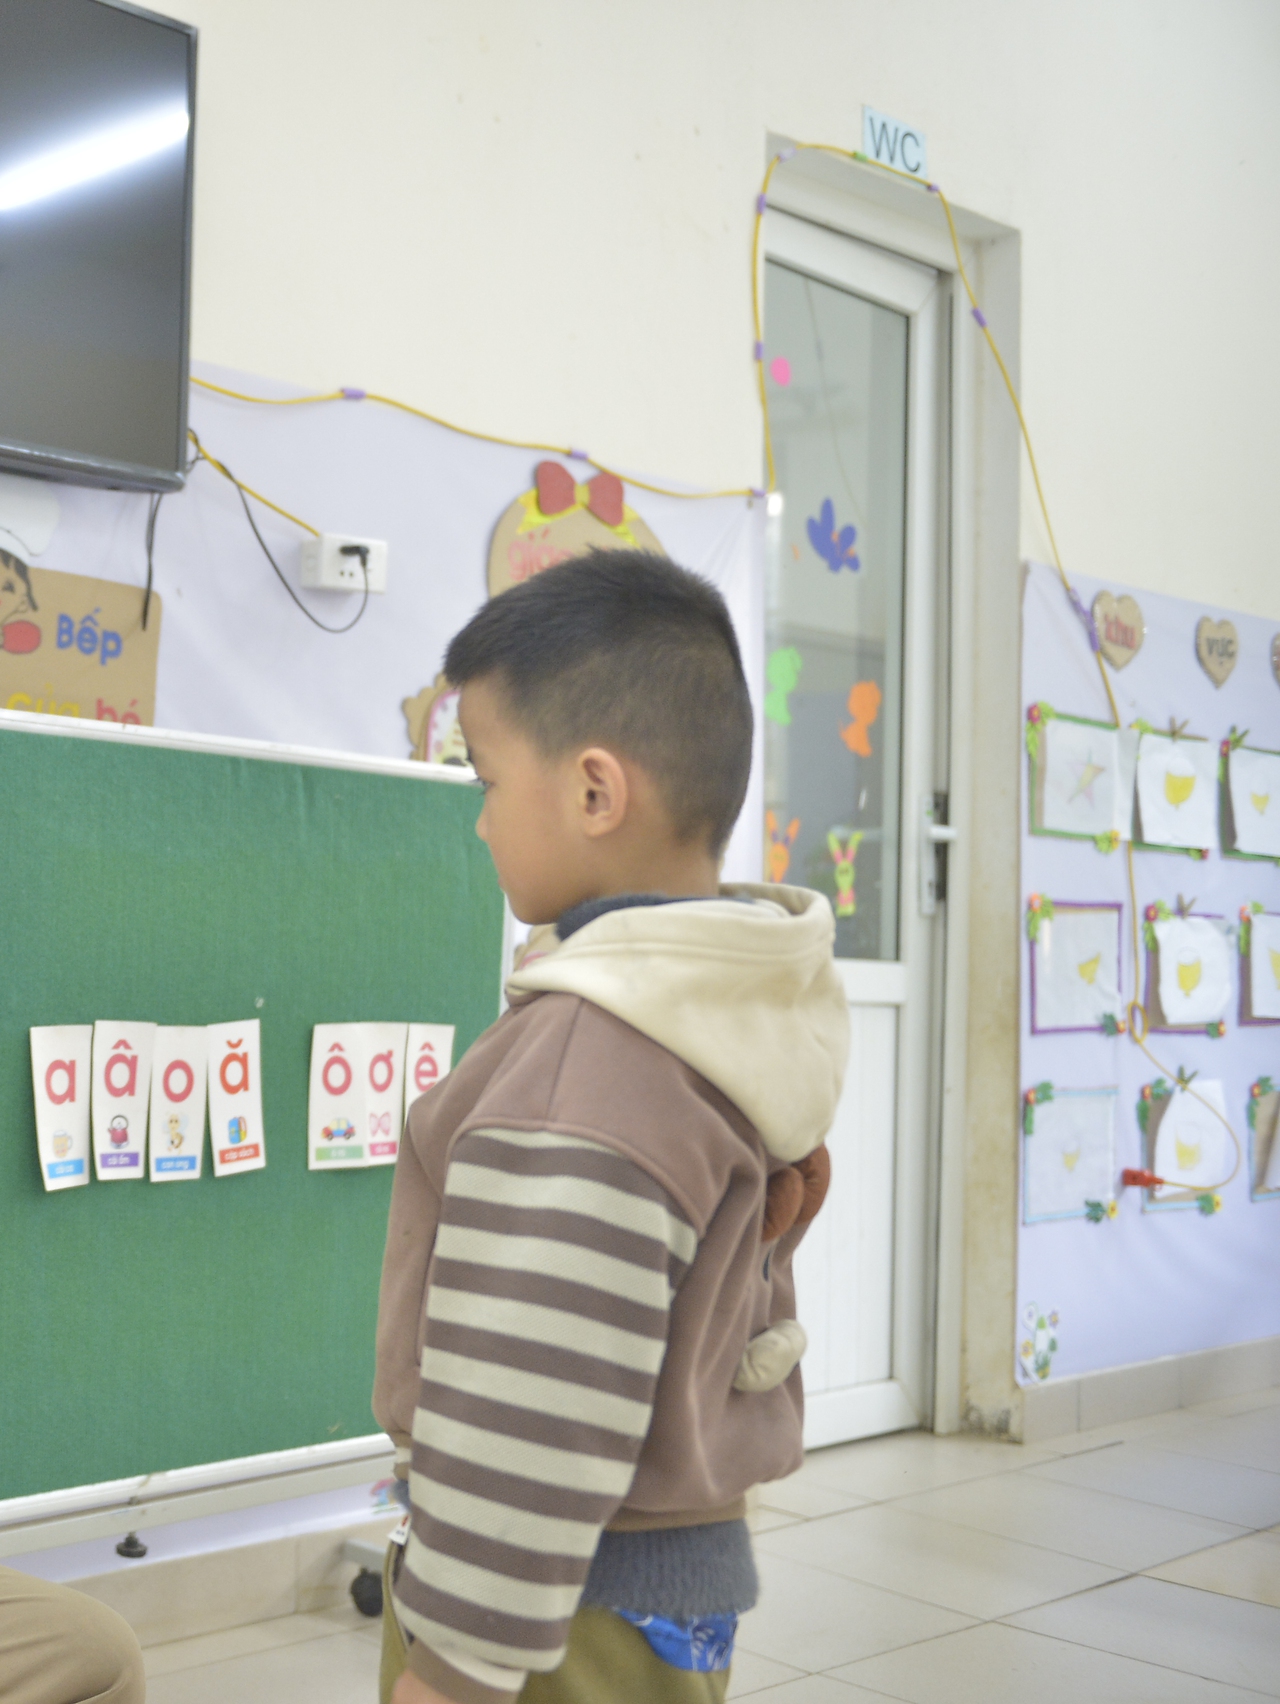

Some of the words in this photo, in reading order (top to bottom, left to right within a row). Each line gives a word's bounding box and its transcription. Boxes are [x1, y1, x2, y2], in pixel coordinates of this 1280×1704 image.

[869, 115, 921, 173] WC
[56, 607, 123, 666] Bếp
[45, 1059, 76, 1105] a
[104, 1039, 138, 1098] â
[162, 1059, 194, 1103] o
[220, 1038, 249, 1095] ă
[322, 1042, 352, 1096] ô
[369, 1049, 394, 1093] ơ
[414, 1041, 439, 1093] ê
